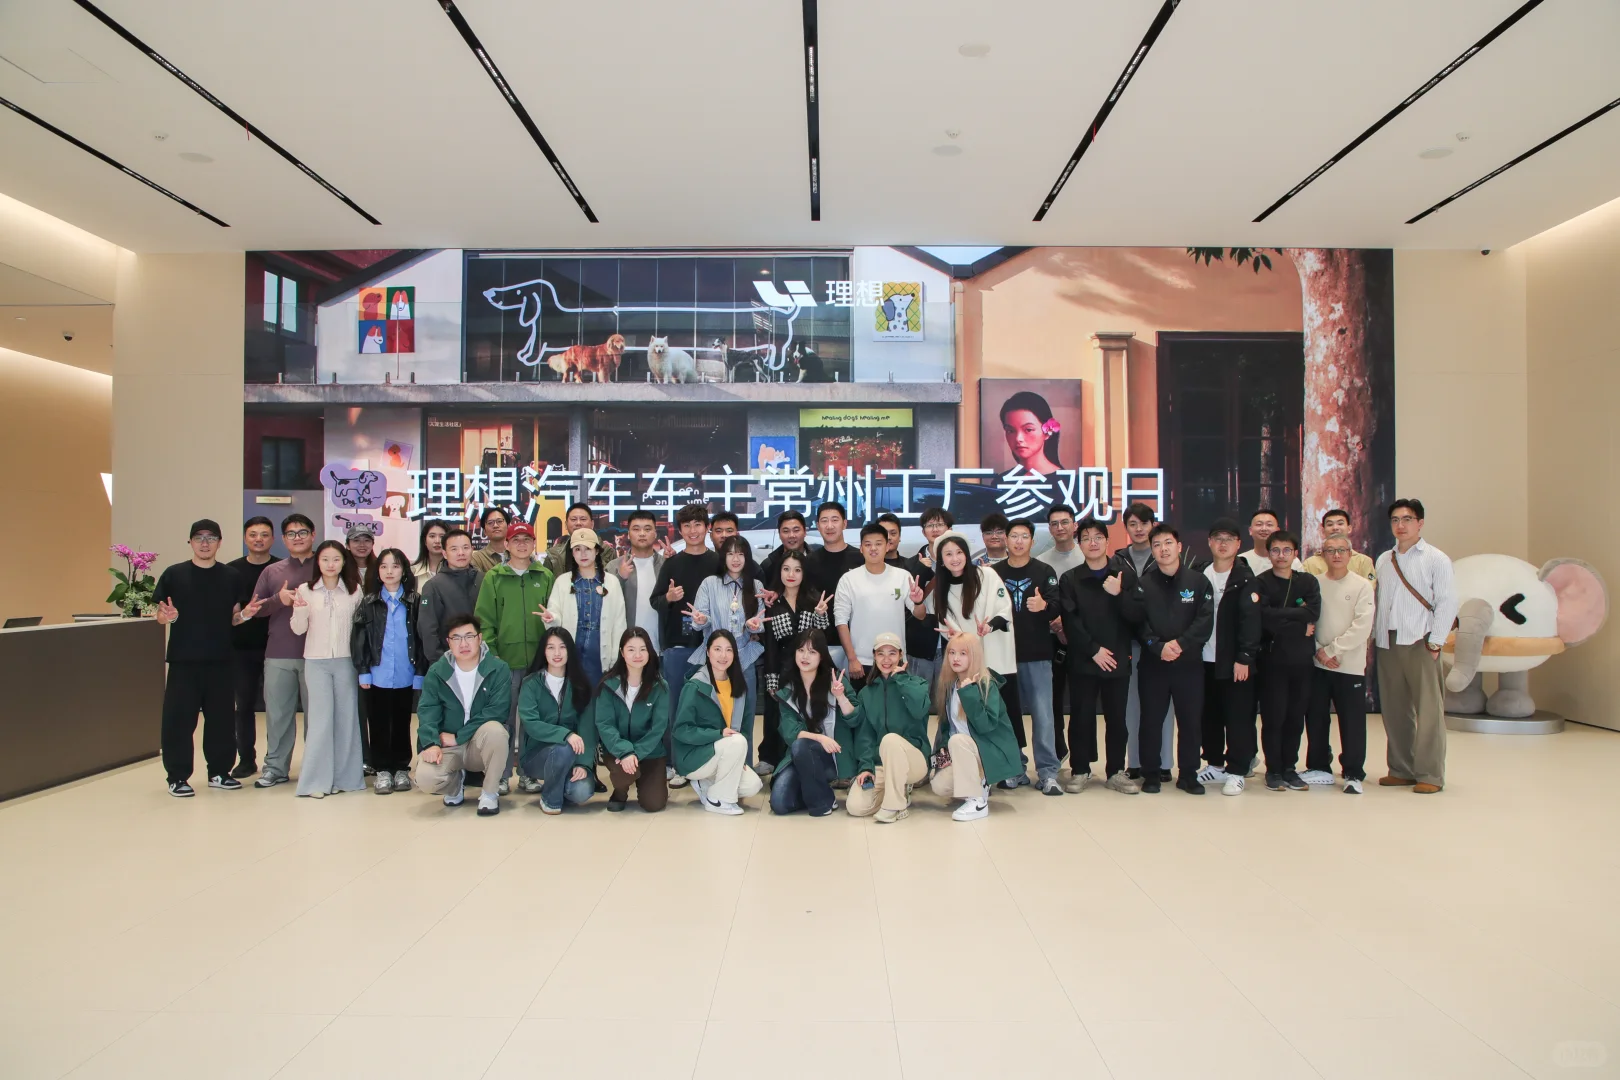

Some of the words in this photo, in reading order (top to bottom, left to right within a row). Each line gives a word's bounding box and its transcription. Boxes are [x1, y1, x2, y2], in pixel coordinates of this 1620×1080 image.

[825, 280, 885, 307] 理想
[843, 414, 858, 422] dogs
[342, 498, 358, 507] Dog
[358, 496, 373, 505] Dog
[406, 463, 1164, 522] 理想汽车车主常州工厂参观日
